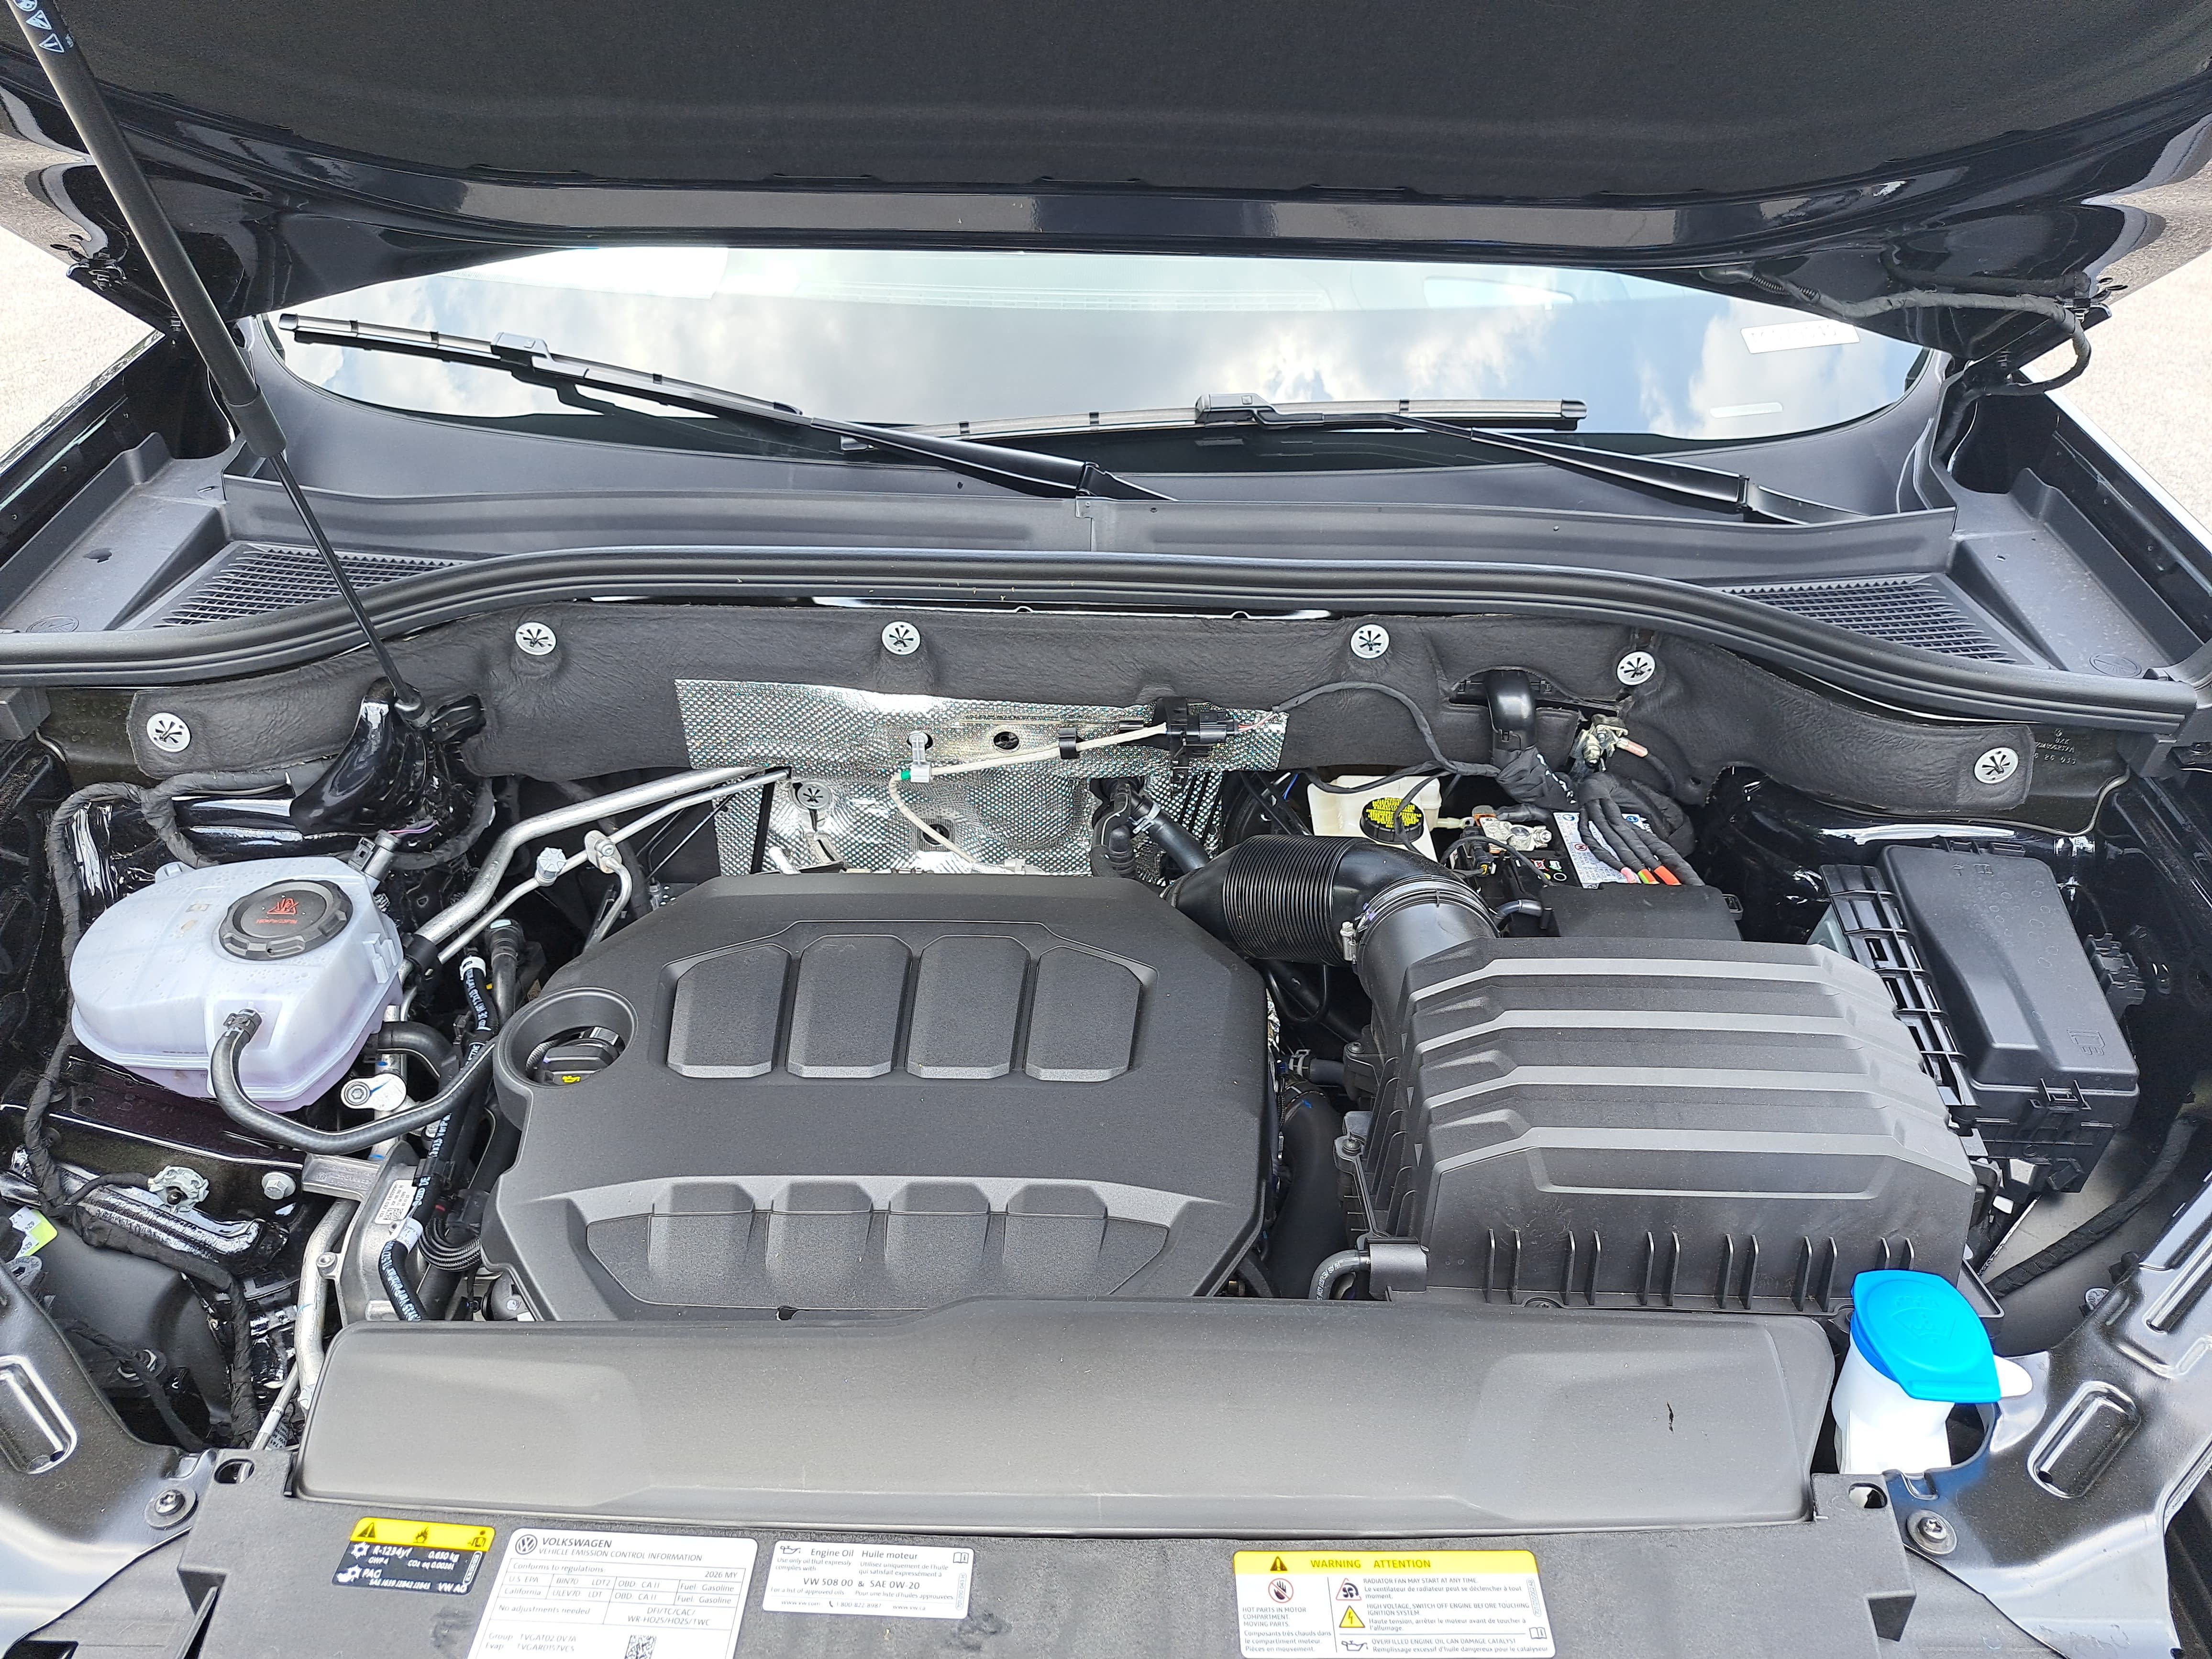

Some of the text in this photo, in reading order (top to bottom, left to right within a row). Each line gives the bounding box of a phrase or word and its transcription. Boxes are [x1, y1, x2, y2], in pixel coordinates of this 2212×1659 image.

[542, 1537, 612, 1548] VOLKSWAGEN
[571, 1549, 608, 1557] EMISSION
[610, 1550, 645, 1559] CONTROL
[648, 1552, 703, 1561] INFORMATION
[811, 1548, 840, 1559] Engine
[862, 1550, 884, 1558] Huile
[1310, 1559, 1431, 1569] WARNING ATTENTION
[438, 1582, 454, 1592] VW
[702, 1584, 734, 1592] Gasoline
[803, 1577, 819, 1585] VW
[889, 1581, 920, 1589] 0W-20
[504, 1588, 541, 1596] California
[511, 1605, 559, 1614] adjustments
